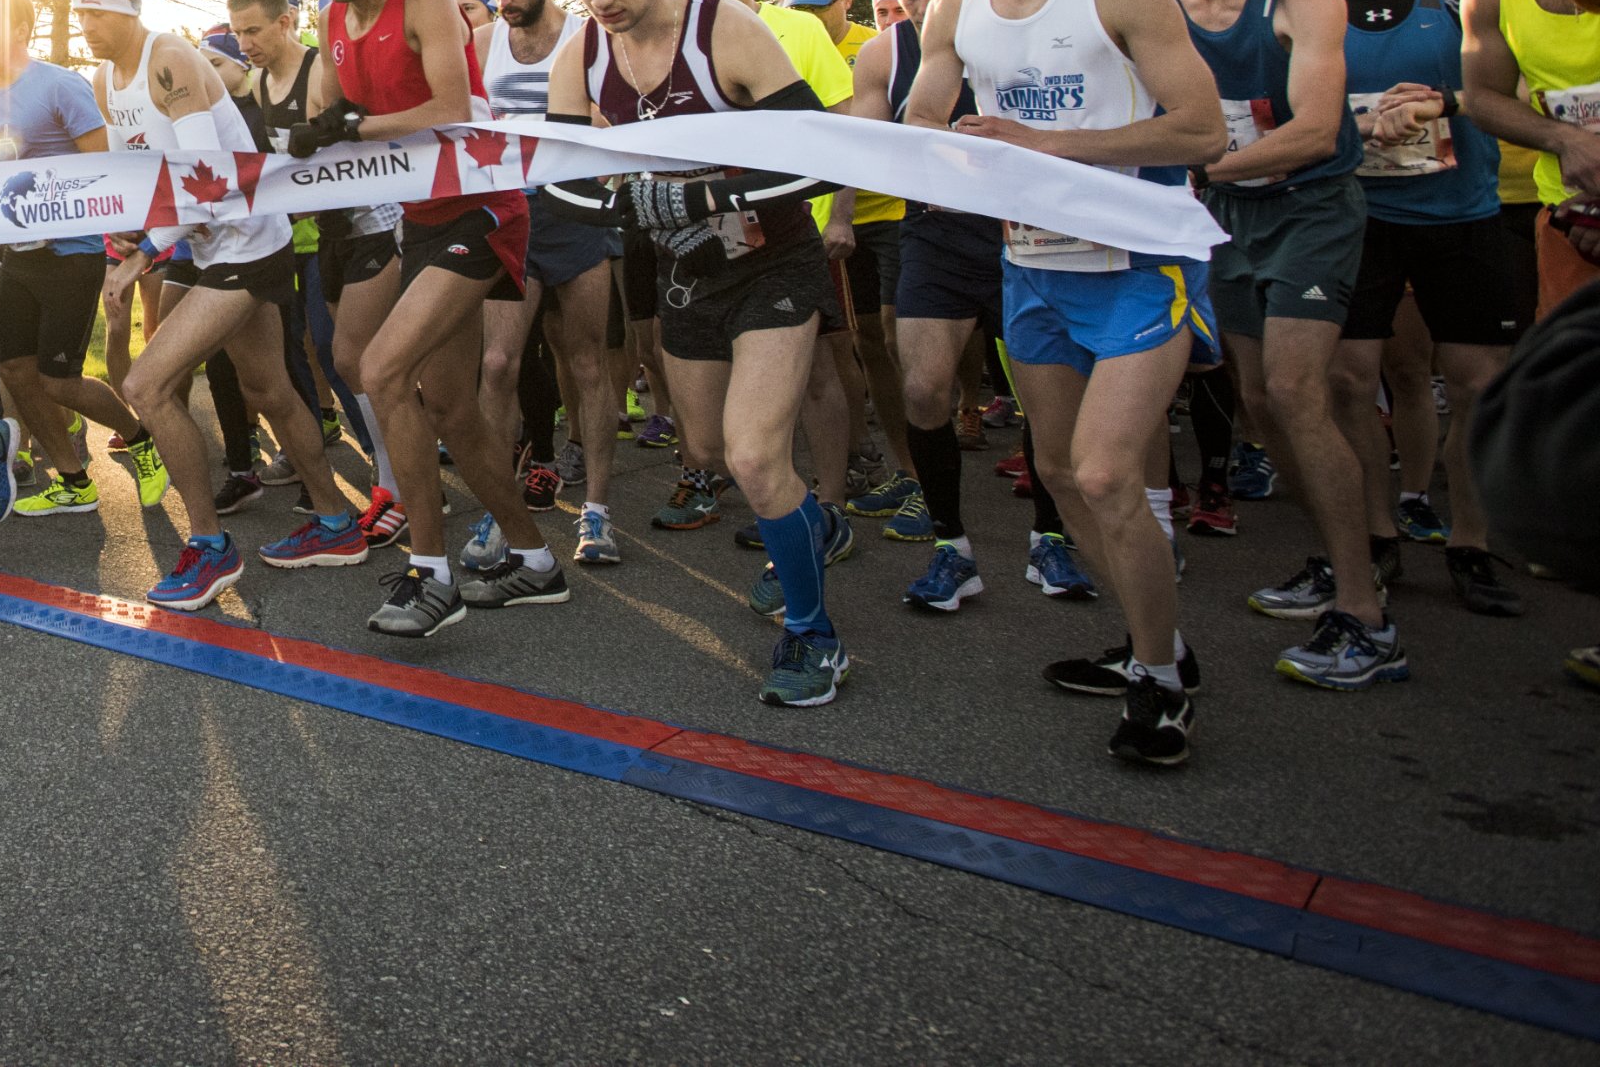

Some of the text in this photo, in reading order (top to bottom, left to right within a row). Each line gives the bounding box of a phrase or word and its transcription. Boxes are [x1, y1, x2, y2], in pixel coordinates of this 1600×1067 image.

[995, 85, 1084, 111] RUNNER'S
[1020, 111, 1056, 120] DEN
[290, 151, 410, 186] GARMIN
[36, 178, 80, 192] WINGS
[43, 190, 68, 202] LIFE
[21, 194, 125, 224] WORLD RUN
